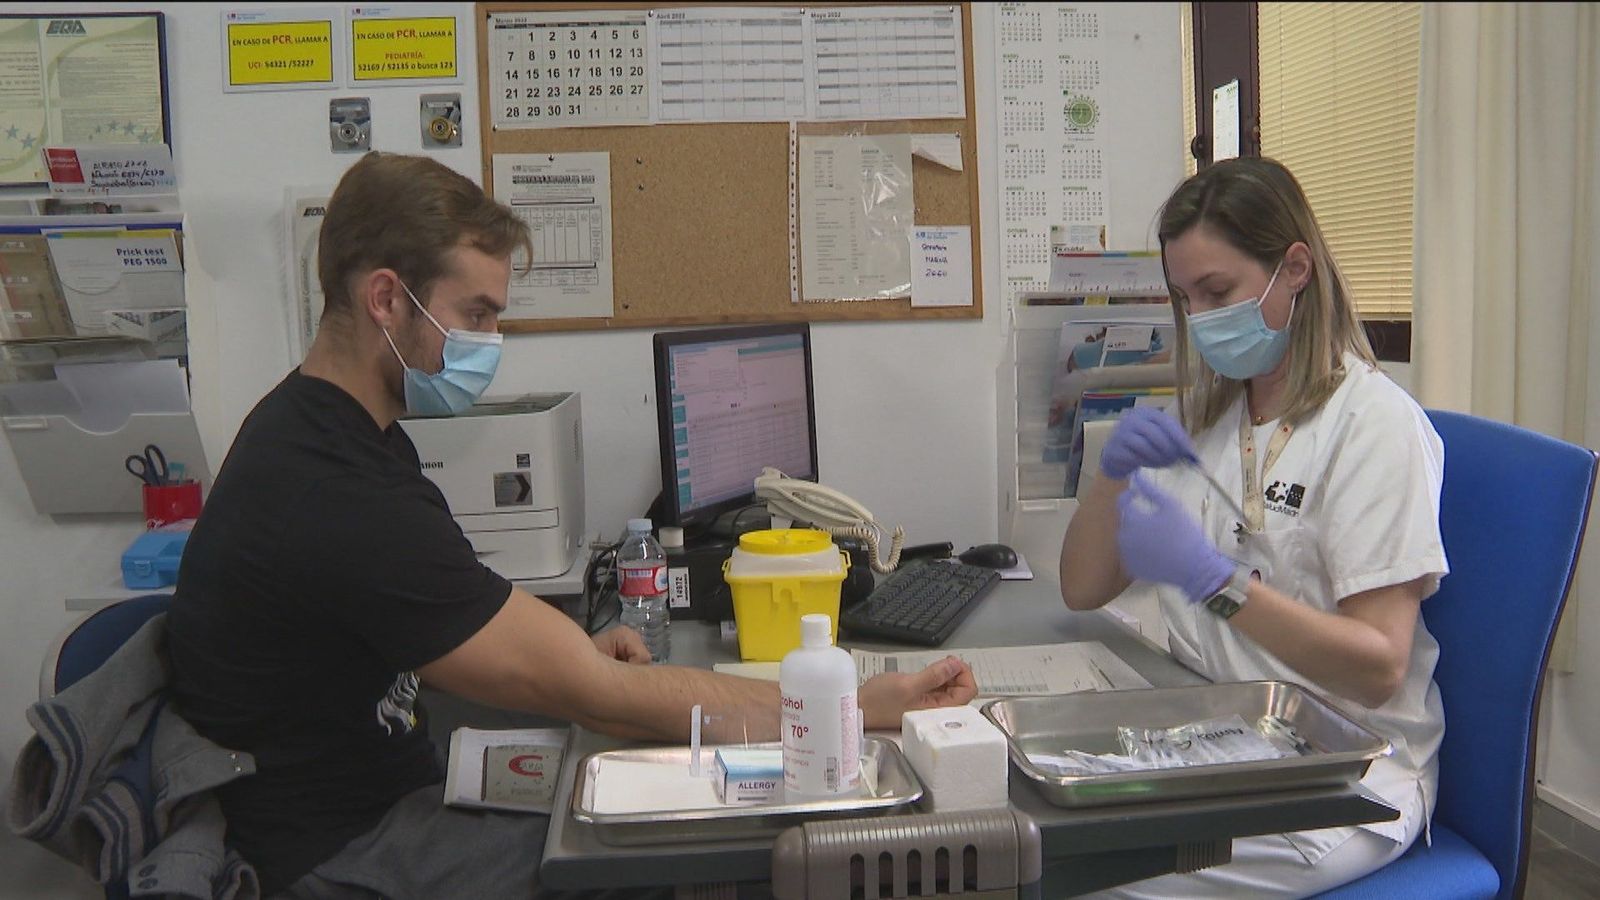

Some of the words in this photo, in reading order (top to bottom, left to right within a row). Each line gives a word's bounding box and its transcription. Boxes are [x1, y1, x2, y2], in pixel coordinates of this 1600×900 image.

[367, 32, 385, 40] CASO
[386, 31, 395, 39] DE
[419, 30, 445, 38] LLAMAR
[529, 32, 534, 41] 1
[549, 32, 556, 41] 2
[570, 31, 577, 40] 3
[590, 31, 598, 39] 4
[612, 30, 619, 39] 5
[632, 30, 640, 39] 6
[243, 38, 261, 46] CASO
[294, 36, 321, 44] LLAMAR
[507, 52, 514, 61] 7
[528, 51, 536, 60] 8
[549, 50, 556, 59] 9
[568, 50, 580, 59] 10
[588, 49, 599, 58] 11
[609, 49, 622, 58] 12
[629, 49, 642, 57] 13
[416, 62, 438, 70] busca
[505, 71, 518, 79] 14
[526, 70, 539, 79] 15
[547, 69, 559, 78] 16
[567, 68, 580, 77] 17
[588, 67, 601, 77] 18
[609, 67, 622, 76] 19
[630, 67, 643, 76] 20
[505, 89, 517, 98] 21
[526, 89, 539, 97] 22
[547, 87, 560, 97] 23
[567, 87, 580, 96] 24
[588, 85, 602, 95] 25
[609, 85, 623, 95] 26
[630, 85, 643, 94] 27
[506, 107, 519, 117] 28
[527, 107, 540, 116] 29
[548, 106, 560, 115] 30
[568, 105, 580, 114] 31
[116, 248, 142, 257] Prick
[144, 248, 164, 256] test
[123, 258, 142, 266] PEG
[145, 258, 167, 266] 1500
[791, 725, 809, 738] 70°
[738, 781, 776, 790] ALLERGY
